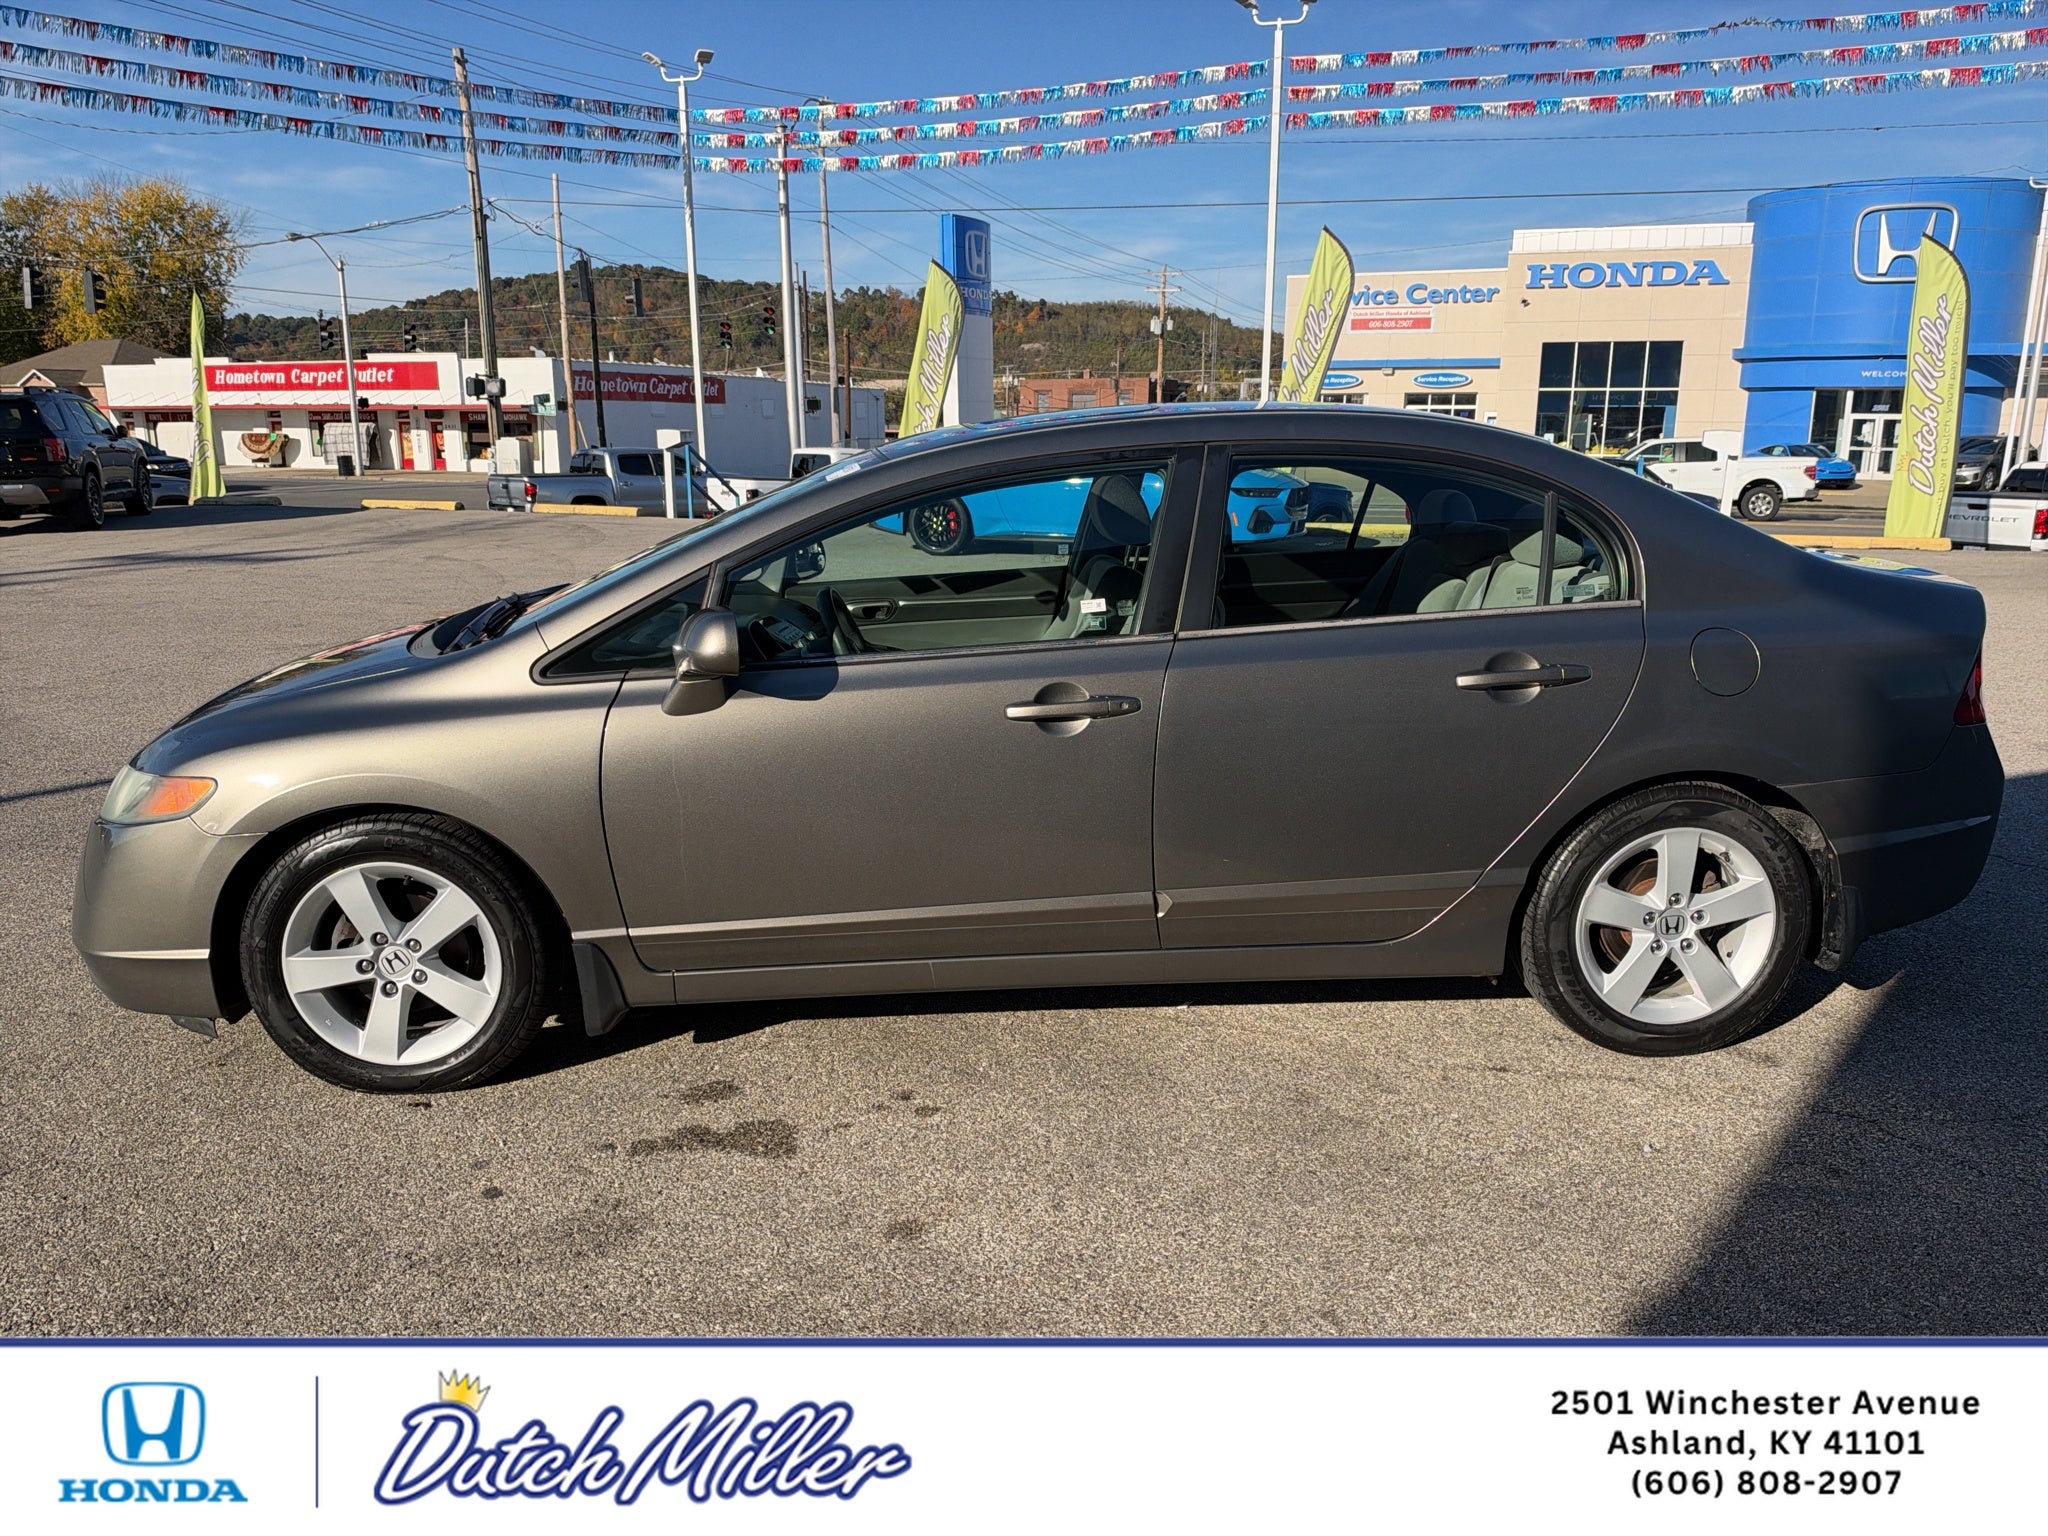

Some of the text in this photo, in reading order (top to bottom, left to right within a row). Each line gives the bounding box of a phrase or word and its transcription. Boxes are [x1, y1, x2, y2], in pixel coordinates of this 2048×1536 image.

[1525, 260, 1731, 290] HONDA
[1350, 282, 1500, 306] vice Center
[1290, 287, 1334, 395] Miller
[1951, 336, 1960, 356] too
[918, 312, 952, 408] Miller
[1950, 360, 1959, 381] pay
[214, 369, 286, 385] Hometown
[291, 367, 345, 387] Carpet
[1416, 375, 1467, 385] Service Reception
[1861, 370, 1908, 378] WELCOM
[649, 377, 689, 399] Carpet
[1908, 293, 1952, 497] Dutch Miller
[467, 413, 486, 421] SHAW
[1949, 514, 2020, 524] EVROLET
